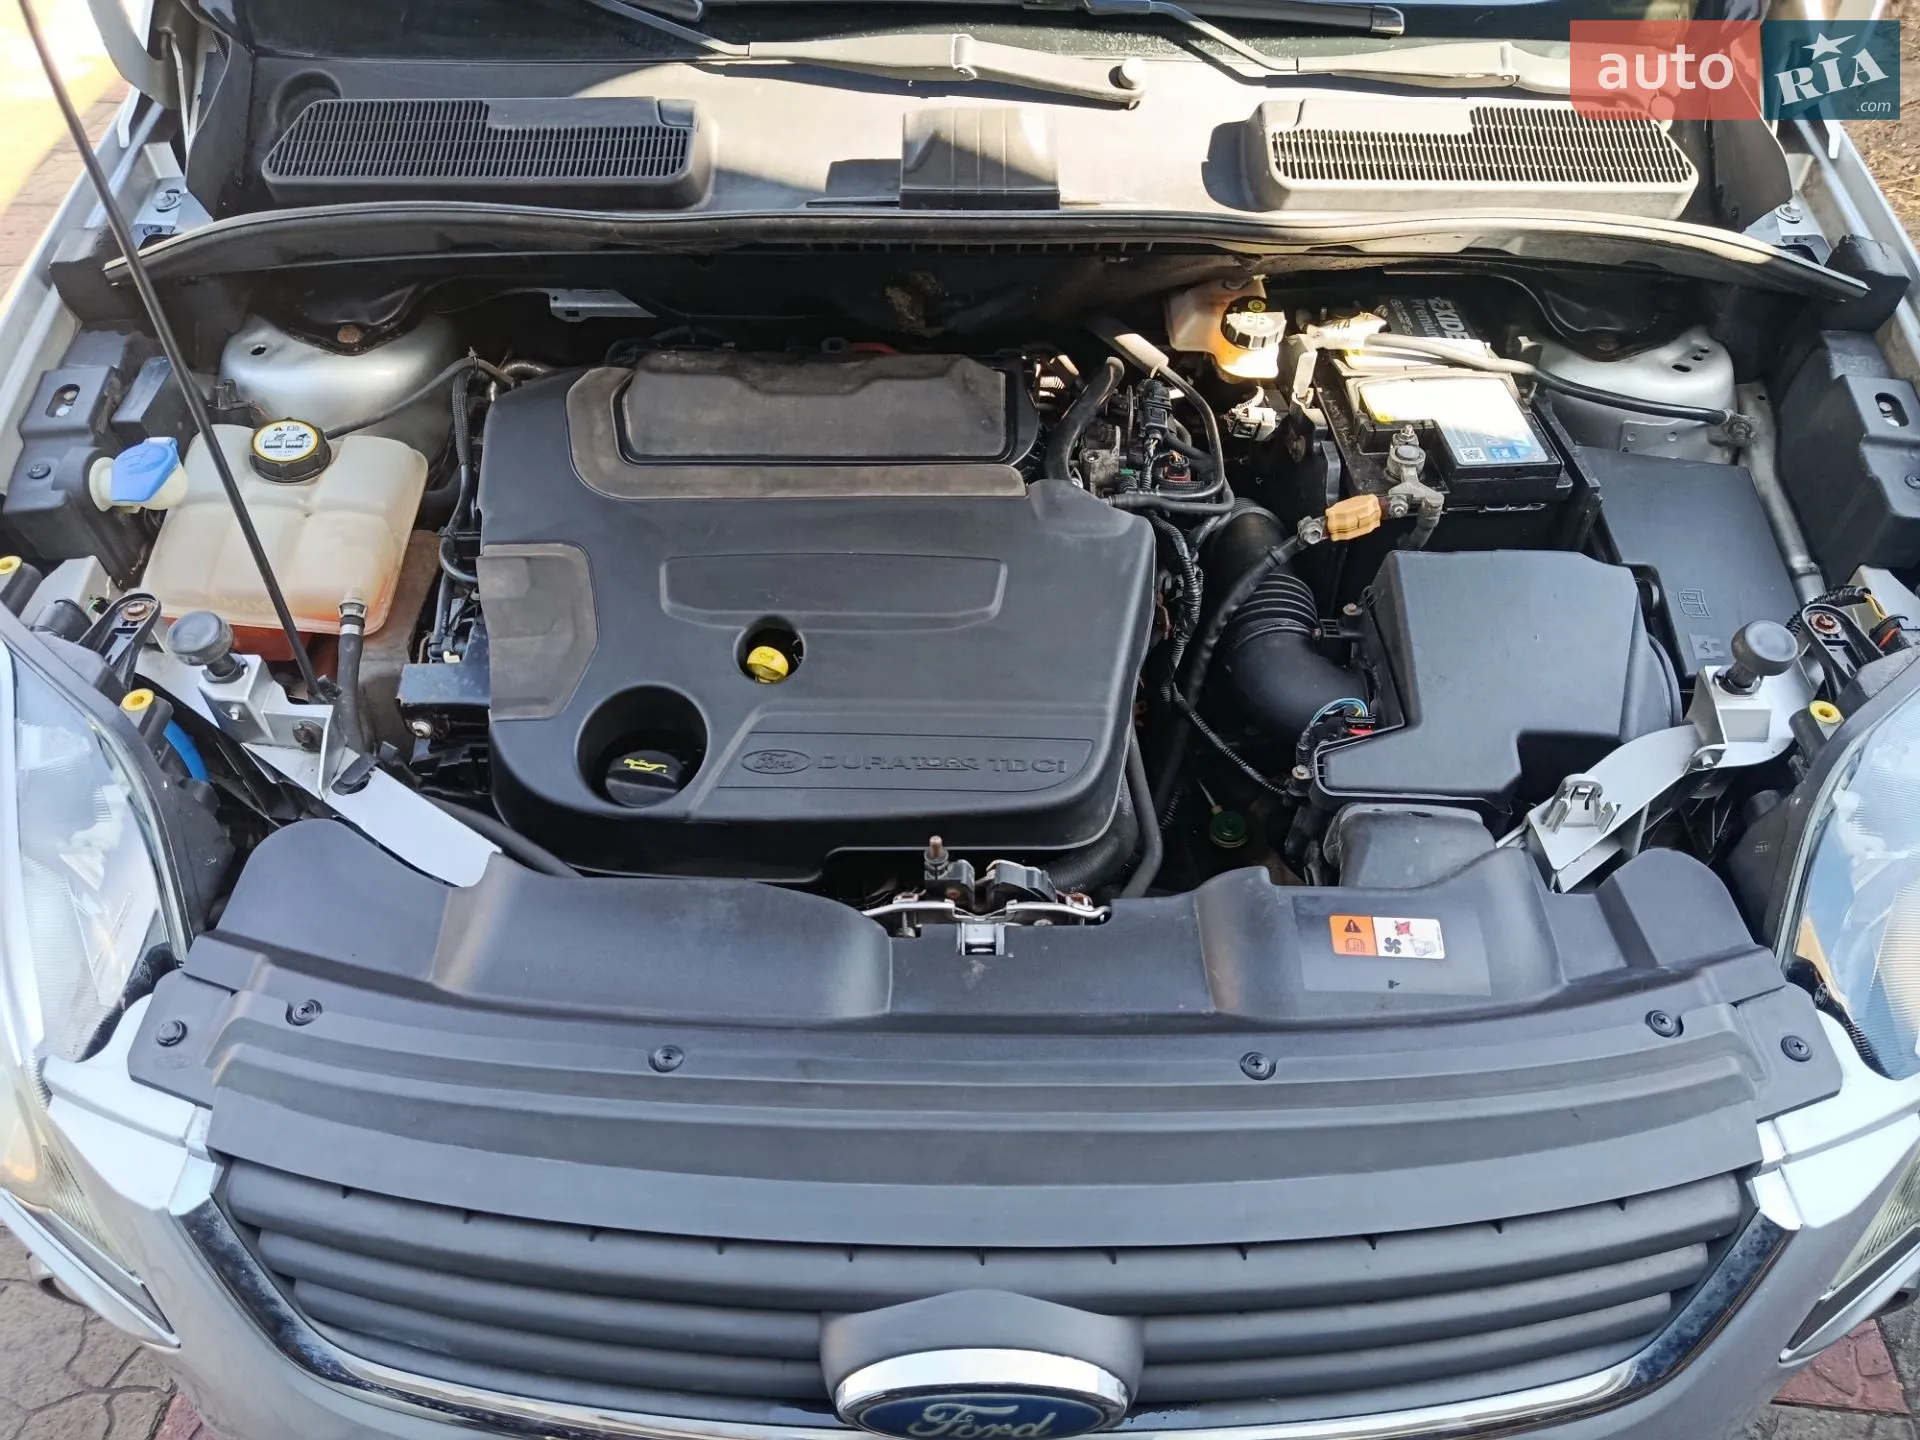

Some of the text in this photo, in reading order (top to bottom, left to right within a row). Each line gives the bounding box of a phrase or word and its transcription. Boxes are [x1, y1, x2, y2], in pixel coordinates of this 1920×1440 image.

[1427, 297, 1470, 340] EXIDE
[817, 755, 980, 771] DURATORQ
[907, 1402, 1057, 1438] Ford
